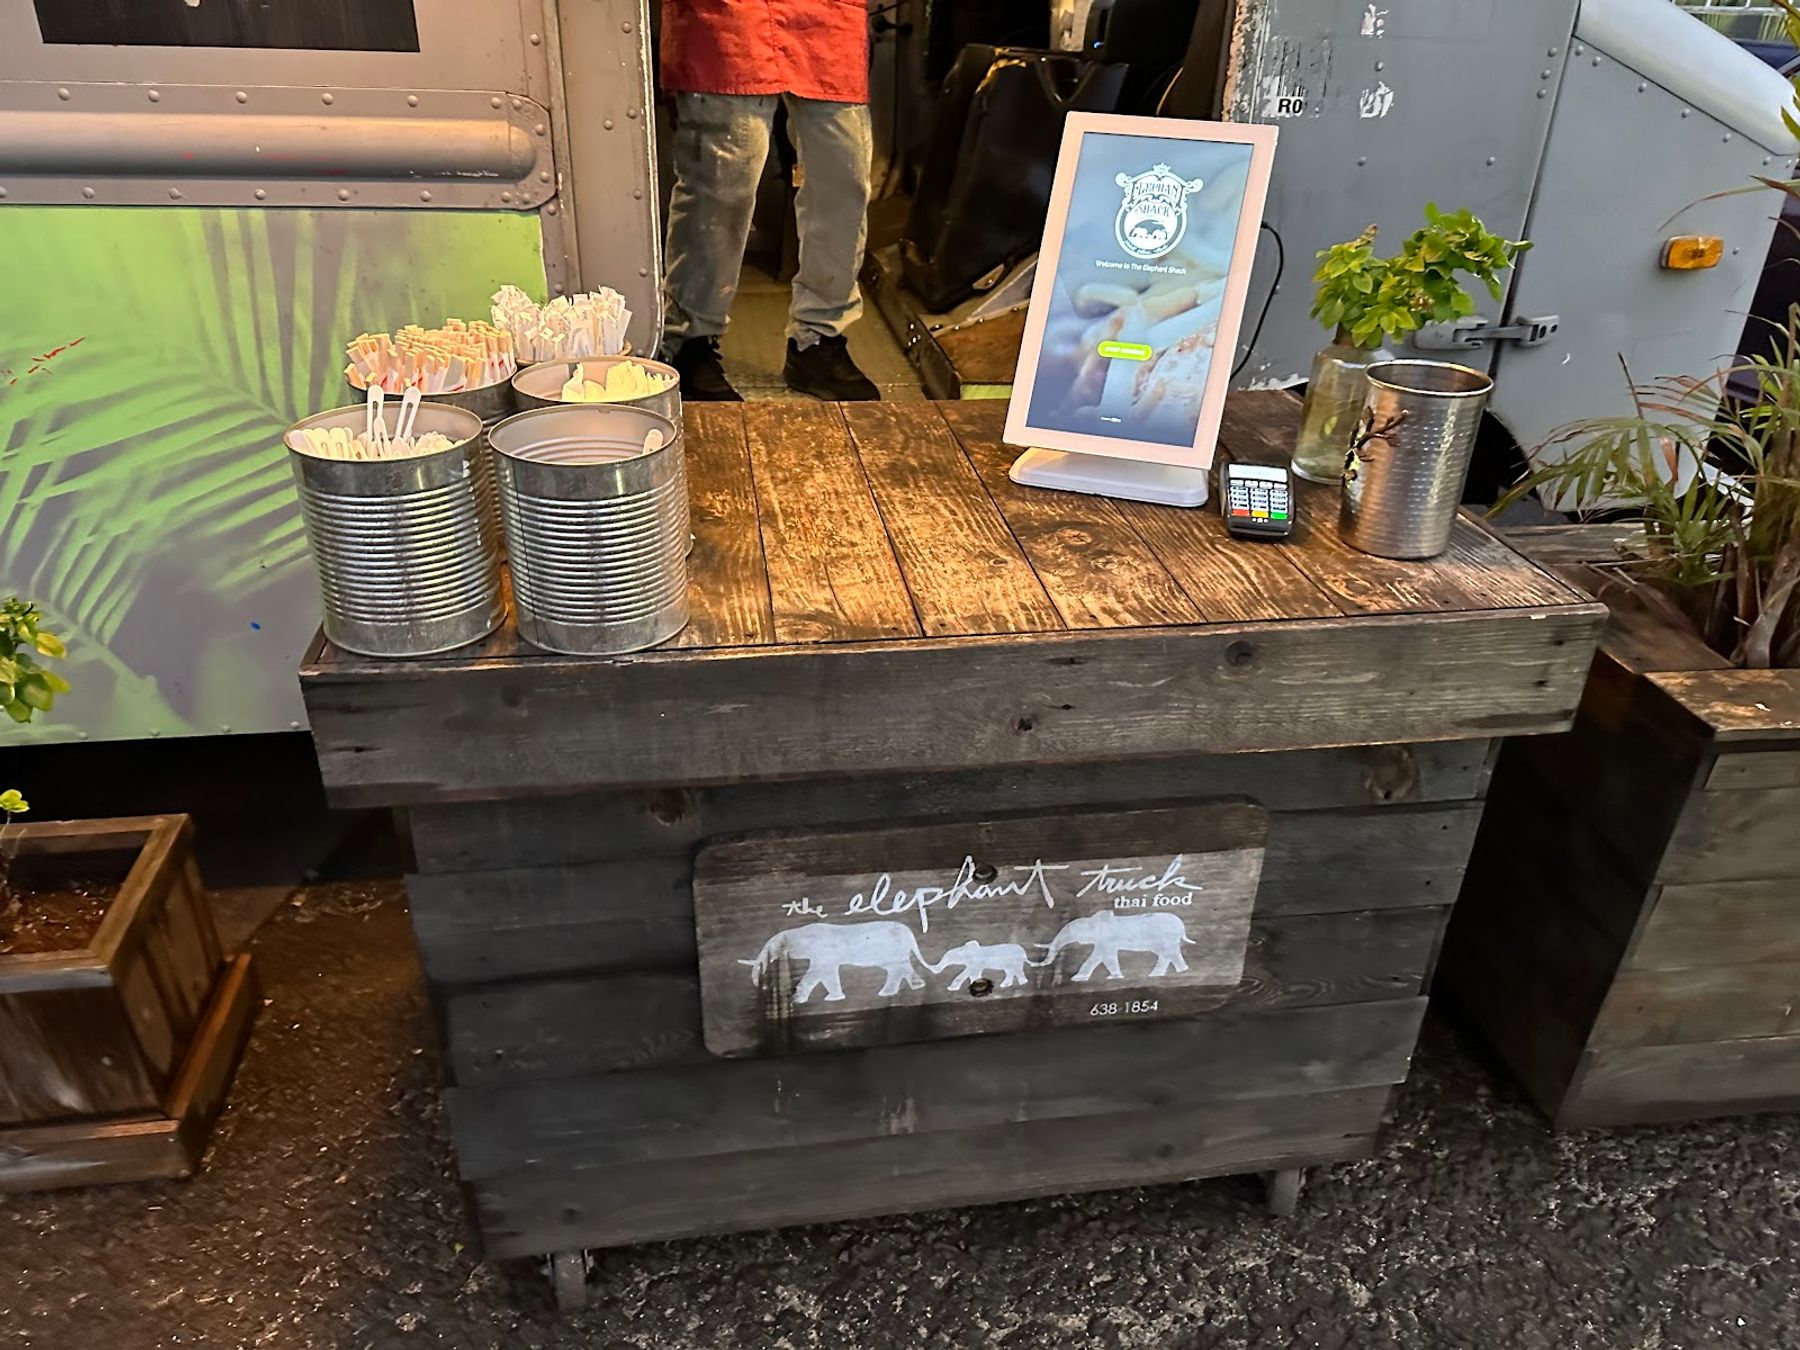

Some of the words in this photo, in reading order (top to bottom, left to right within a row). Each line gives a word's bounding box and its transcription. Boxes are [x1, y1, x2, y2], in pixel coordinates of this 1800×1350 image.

[1135, 204, 1170, 218] SHACK
[1095, 260, 1123, 269] Welcome
[1123, 262, 1130, 270] to
[1131, 262, 1142, 271] The
[1142, 264, 1168, 274] Elephant
[1168, 266, 1187, 275] Shack
[781, 898, 827, 918] the
[843, 854, 1070, 933] elephant
[1076, 853, 1203, 898] truck
[1113, 895, 1148, 909] thai
[1152, 891, 1193, 908] food
